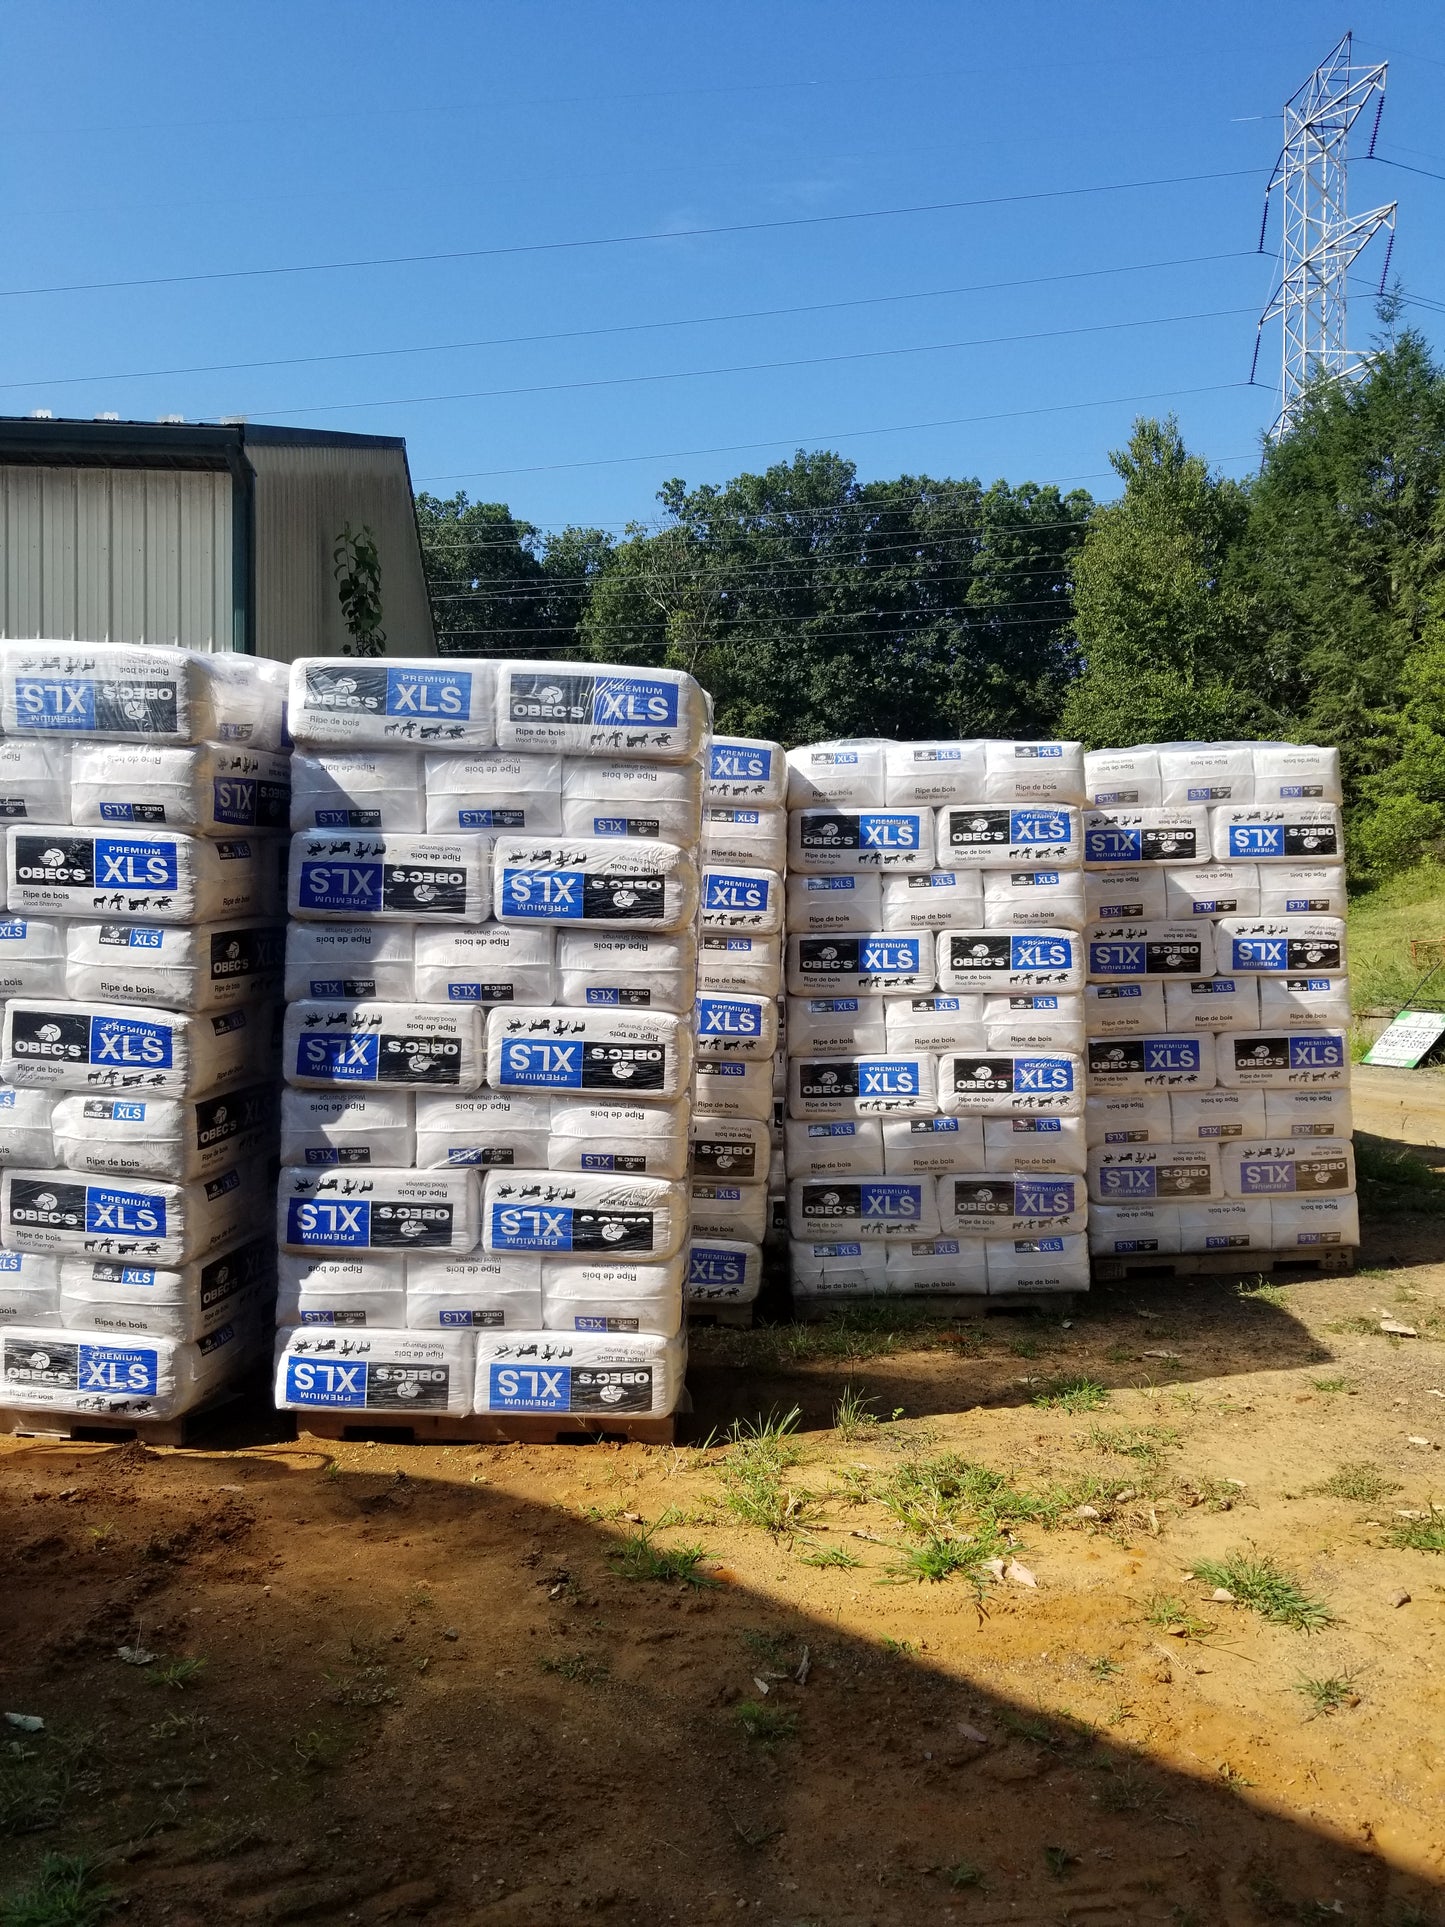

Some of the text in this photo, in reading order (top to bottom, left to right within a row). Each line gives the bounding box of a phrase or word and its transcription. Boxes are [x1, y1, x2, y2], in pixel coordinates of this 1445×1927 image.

[402, 674, 456, 684] PREMIUM
[609, 685, 663, 694] PREMIUM
[24, 685, 86, 713] XLS
[395, 683, 462, 713] XLS
[603, 694, 668, 720] XLS
[30, 714, 86, 723] PREMIUM
[310, 715, 359, 726] Ripe de bois
[516, 728, 534, 736] Ripe
[721, 749, 760, 758] PREMIUM
[1043, 748, 1060, 756] XLS
[715, 756, 763, 776] XLS
[1015, 784, 1029, 793] Ripe
[221, 784, 252, 810] XLS
[104, 805, 129, 816] XLS
[737, 813, 756, 822] XLS
[866, 825, 913, 845] XLS
[1017, 819, 1065, 840] XLS
[1091, 833, 1136, 851] XLS
[1234, 828, 1278, 847] XLS
[109, 846, 161, 855] PREMIUM
[711, 849, 724, 858] Ripe
[103, 856, 169, 884] XLS
[310, 868, 374, 896] XLS
[719, 879, 757, 888] PREMIUM
[1038, 873, 1056, 884] XLS
[23, 891, 39, 900] Ripe
[53, 891, 70, 900] bois
[511, 876, 576, 903] XLS
[315, 896, 367, 904] PREMIUM
[712, 886, 761, 906] XLS
[517, 903, 568, 912] PREMIUM
[1288, 900, 1306, 909] XLS
[134, 934, 158, 946] XLS
[316, 936, 334, 944] bois
[1017, 944, 1065, 966] XLS
[1096, 946, 1139, 964] XLS
[1238, 942, 1282, 960] XLS
[865, 949, 913, 969] XLS
[101, 983, 117, 992] Ripe
[136, 985, 155, 994] bois
[452, 986, 476, 996] XLS
[1312, 982, 1328, 991] XLS
[712, 1004, 750, 1014] PREMIUM
[706, 1010, 755, 1031] XLS
[105, 1023, 156, 1037] PREMIUM
[98, 1034, 164, 1062] XLS
[307, 1040, 371, 1065] XLS
[510, 1044, 575, 1073] XLS
[1150, 1050, 1194, 1068] XLS
[1296, 1046, 1338, 1065] XLS
[312, 1064, 362, 1074] PREMIUM
[724, 1065, 742, 1075] XLS
[516, 1072, 567, 1081] PREMIUM
[865, 1072, 912, 1093] XLS
[1020, 1068, 1068, 1088] XLS
[117, 1107, 142, 1119] XLS
[311, 1103, 365, 1111] Ripe de bois
[86, 1157, 140, 1167] Ripe de bois
[1106, 1170, 1149, 1187] XLS
[1247, 1165, 1289, 1183] XLS
[100, 1195, 150, 1207] PREMIUM
[868, 1194, 916, 1216] XLS
[1021, 1192, 1069, 1212] XLS
[94, 1203, 158, 1231] XLS
[297, 1205, 361, 1231] XLS
[500, 1211, 565, 1236] XLS
[302, 1232, 354, 1240] PREMIUM
[507, 1236, 558, 1246] PREMIUM
[1042, 1242, 1060, 1251] XLS
[697, 1253, 736, 1262] PREMIUM
[691, 1259, 739, 1280] XLS
[126, 1271, 150, 1284] XLS
[604, 1272, 615, 1280] de
[618, 1273, 636, 1281] Ripe
[94, 1318, 147, 1329] Ripe de bois
[92, 1352, 142, 1361] PREMIUM
[86, 1361, 149, 1389] XLS
[295, 1364, 359, 1393] XLS
[498, 1370, 562, 1398] XLS
[301, 1391, 351, 1401] PREMIUM
[505, 1398, 555, 1407] PREMIUM
